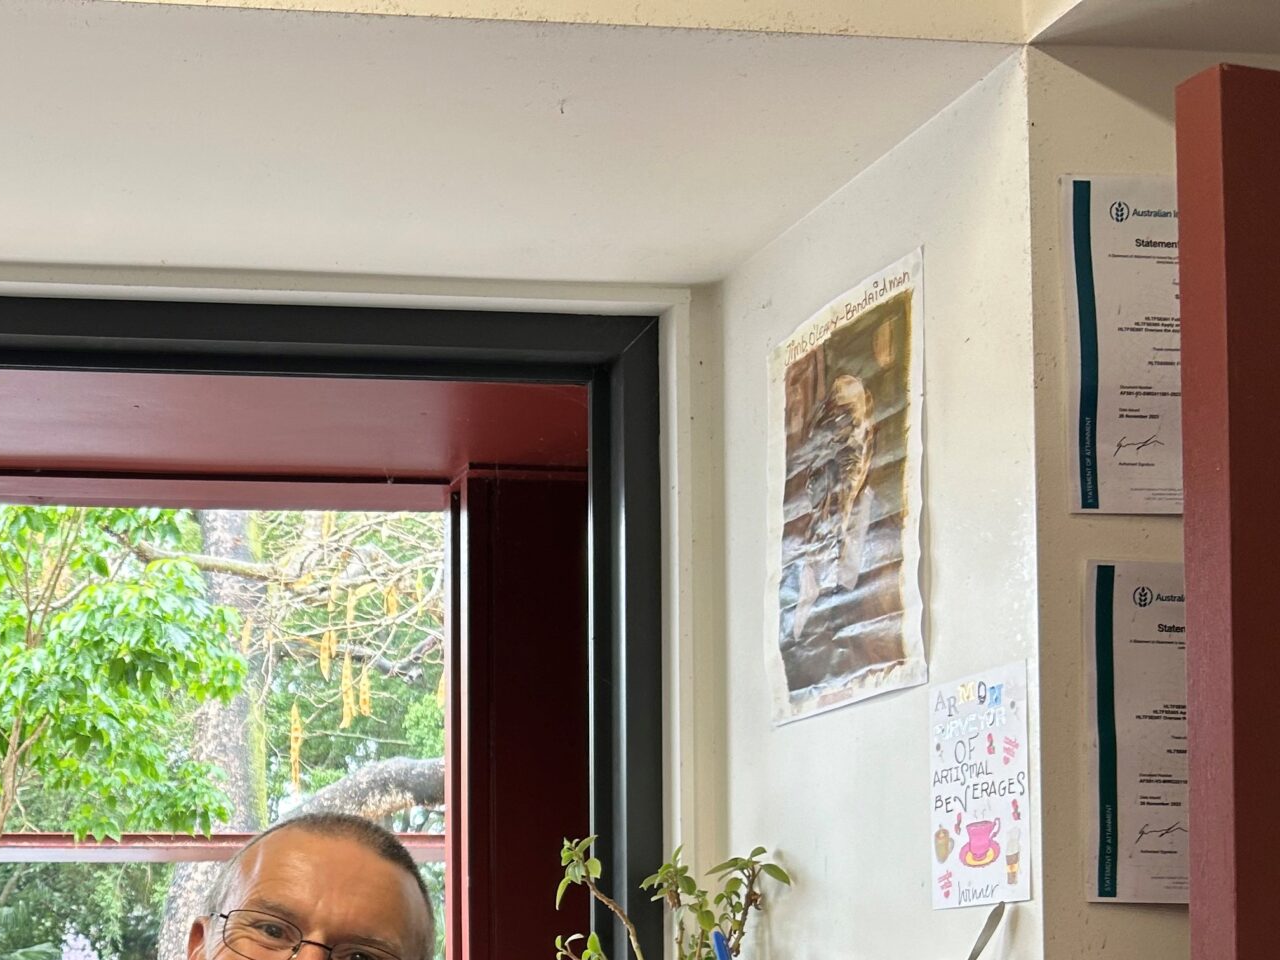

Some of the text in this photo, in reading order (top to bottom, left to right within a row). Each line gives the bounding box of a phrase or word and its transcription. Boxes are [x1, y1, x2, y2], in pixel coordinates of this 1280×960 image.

[1132, 207, 1172, 218] Australian
[954, 732, 980, 764] OF
[934, 771, 1025, 813] BEVERAGES
